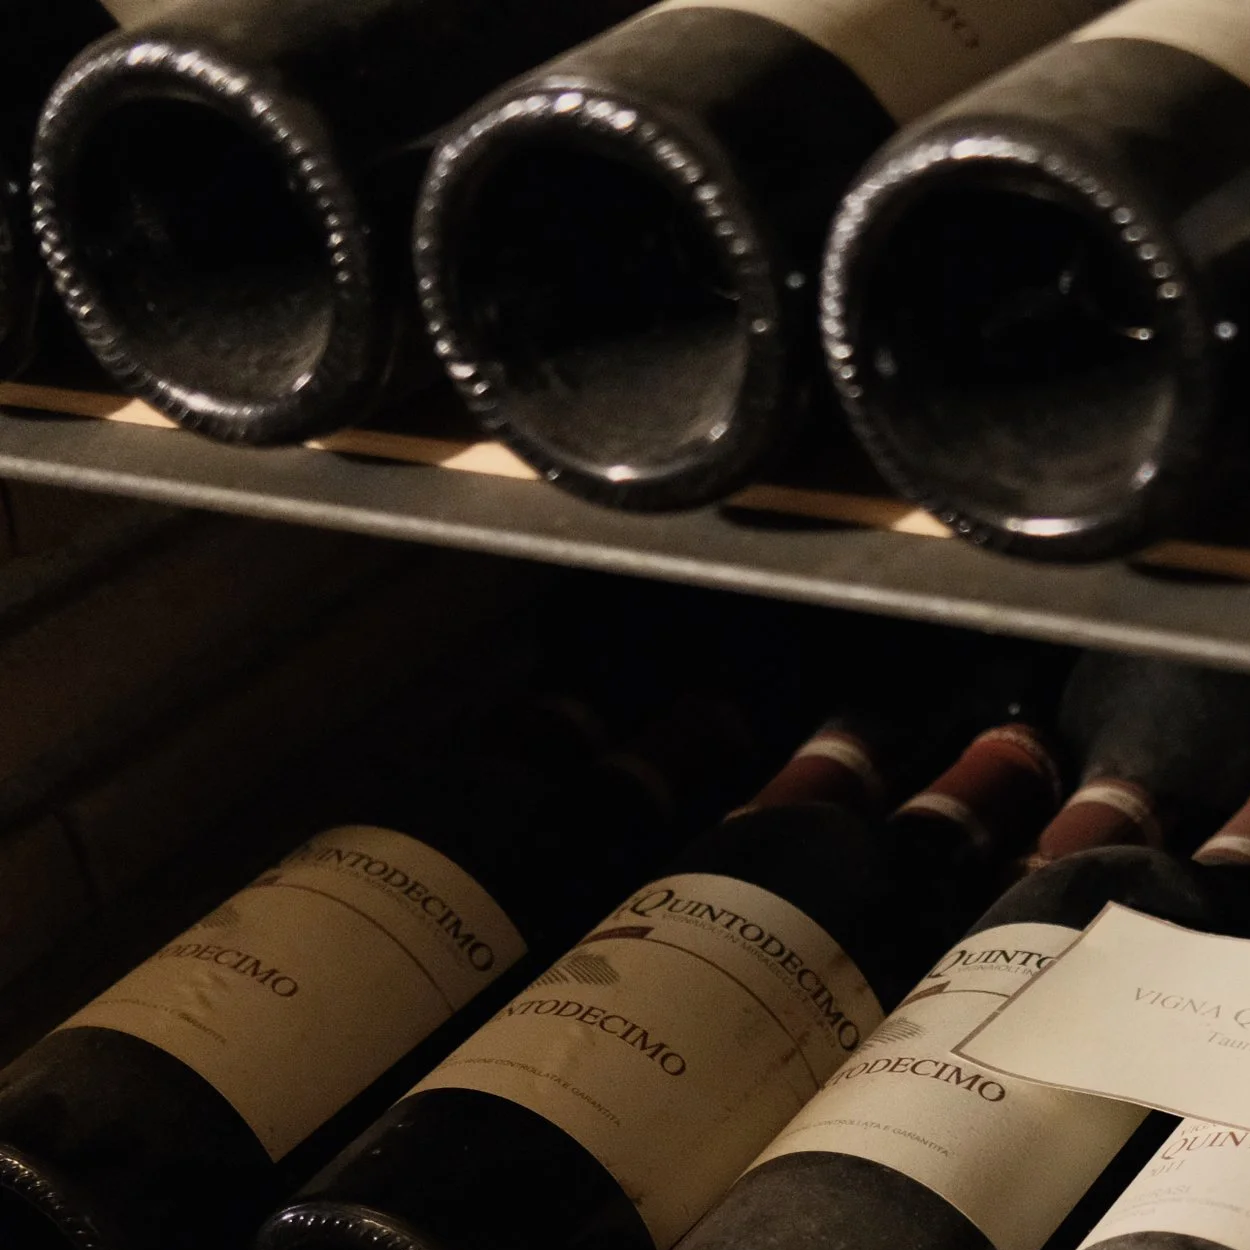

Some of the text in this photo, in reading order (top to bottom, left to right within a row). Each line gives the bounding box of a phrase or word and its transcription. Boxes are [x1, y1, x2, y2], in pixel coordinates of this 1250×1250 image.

[314, 848, 494, 972] INTODECIMO
[630, 889, 859, 1051] QUINTODECIMO
[1134, 986, 1222, 1019] VIGNA
